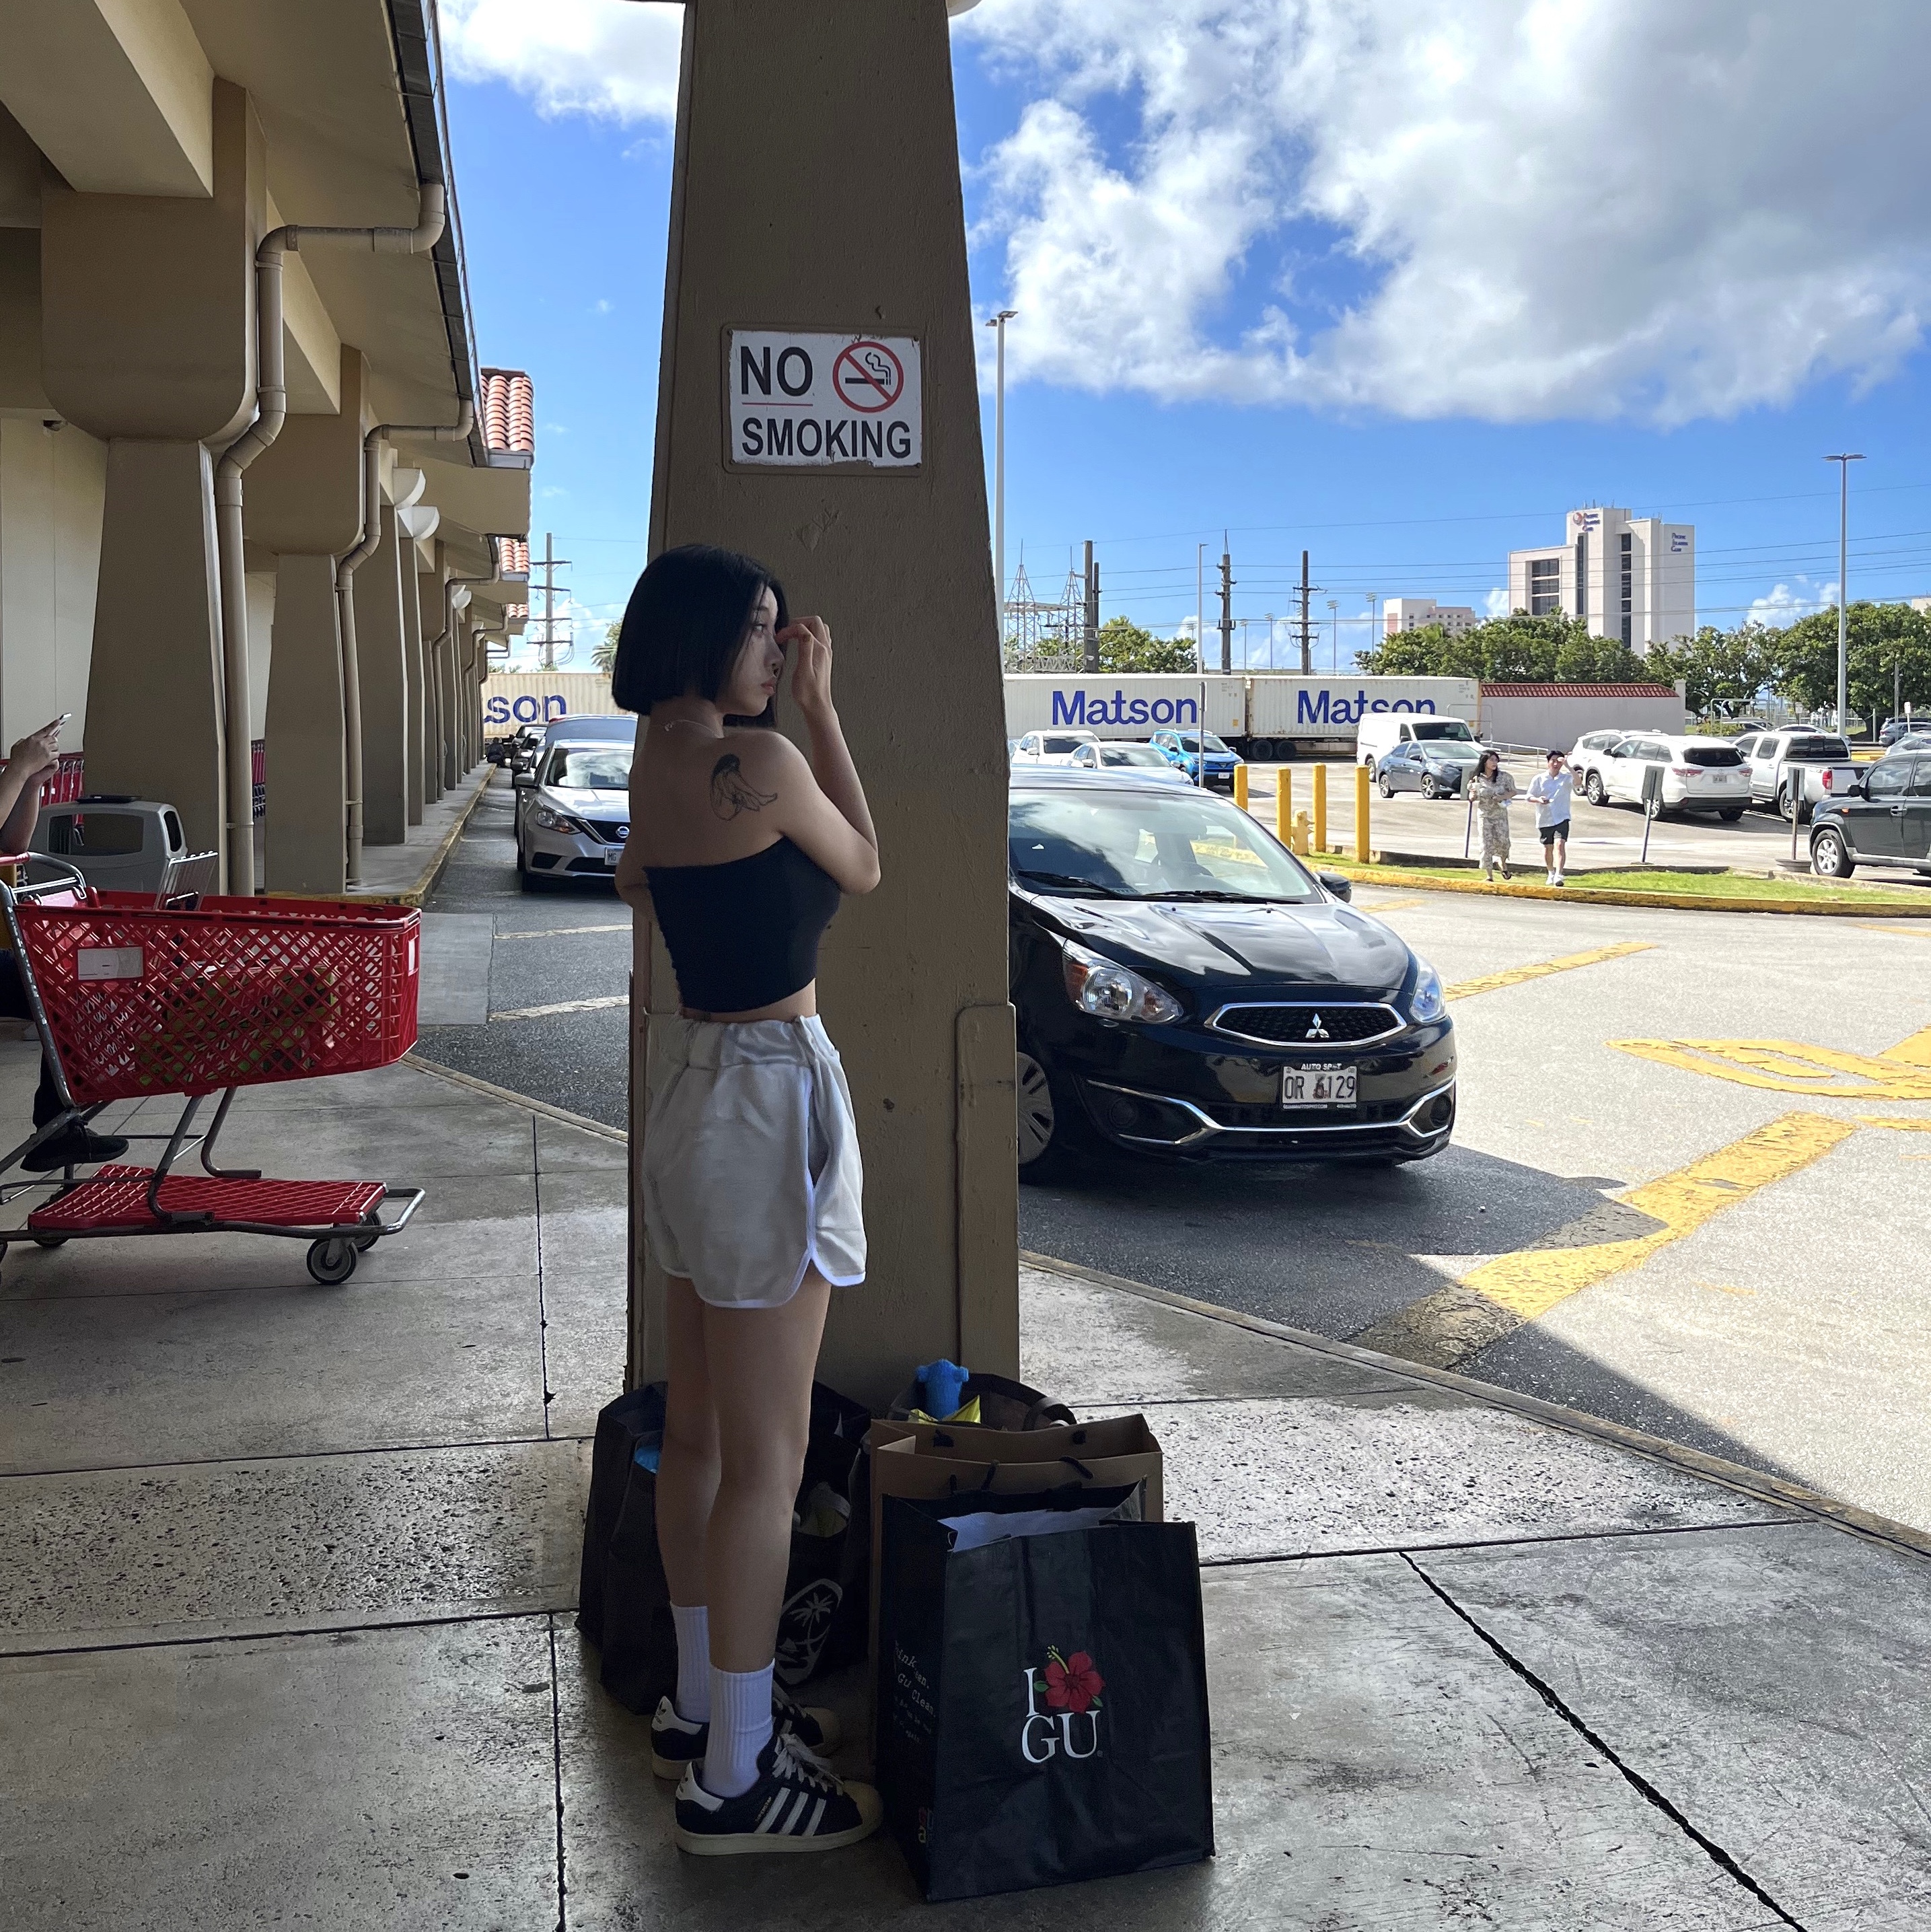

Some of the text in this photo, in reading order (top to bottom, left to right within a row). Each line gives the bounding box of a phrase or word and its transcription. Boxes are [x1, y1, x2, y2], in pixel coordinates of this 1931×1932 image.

[740, 346, 813, 396] NO
[741, 417, 911, 459] SMOKING
[484, 694, 567, 723] son
[1052, 690, 1197, 725] Matson
[1284, 1075, 1305, 1100] OR
[1023, 1667, 1040, 1717] I
[1021, 1710, 1101, 1764] GU
